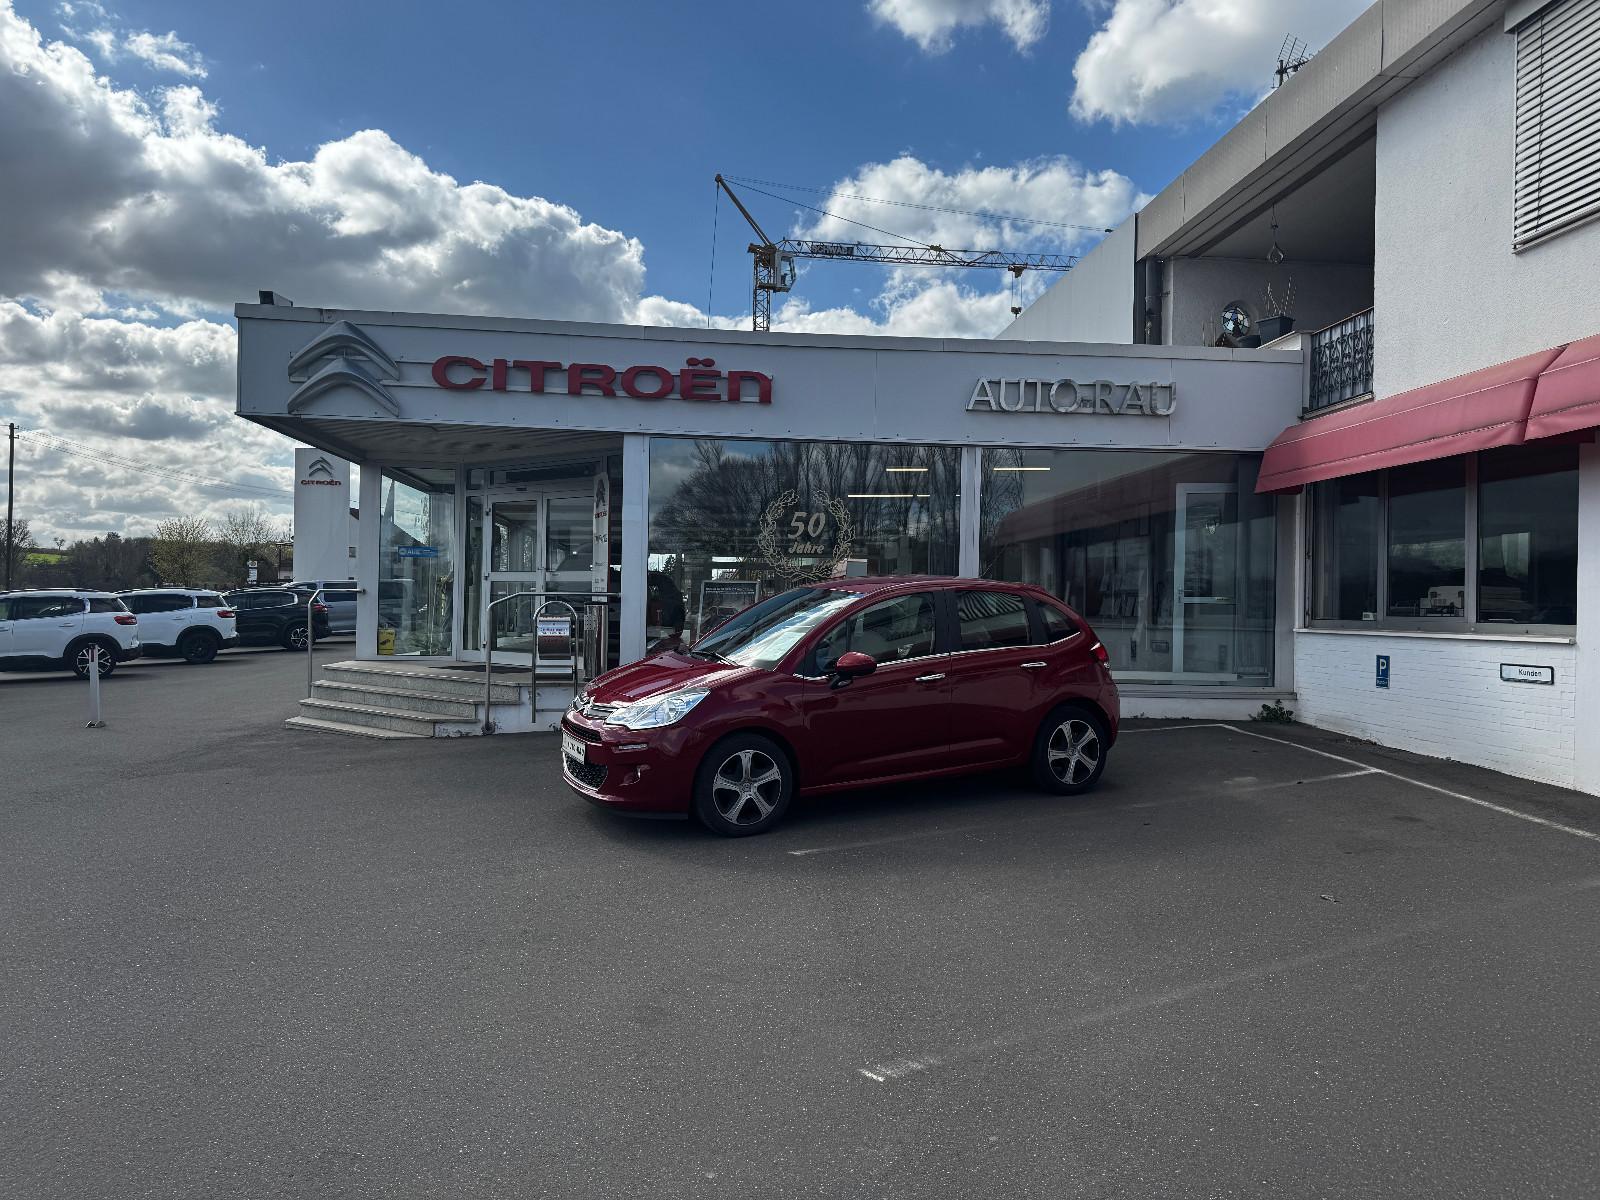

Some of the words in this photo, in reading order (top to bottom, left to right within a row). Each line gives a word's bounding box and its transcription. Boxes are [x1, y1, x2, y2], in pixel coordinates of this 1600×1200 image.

[787, 511, 826, 539] 50
[788, 541, 825, 554] Jahre
[1379, 658, 1387, 676] P
[1518, 668, 1542, 677] Kunden
